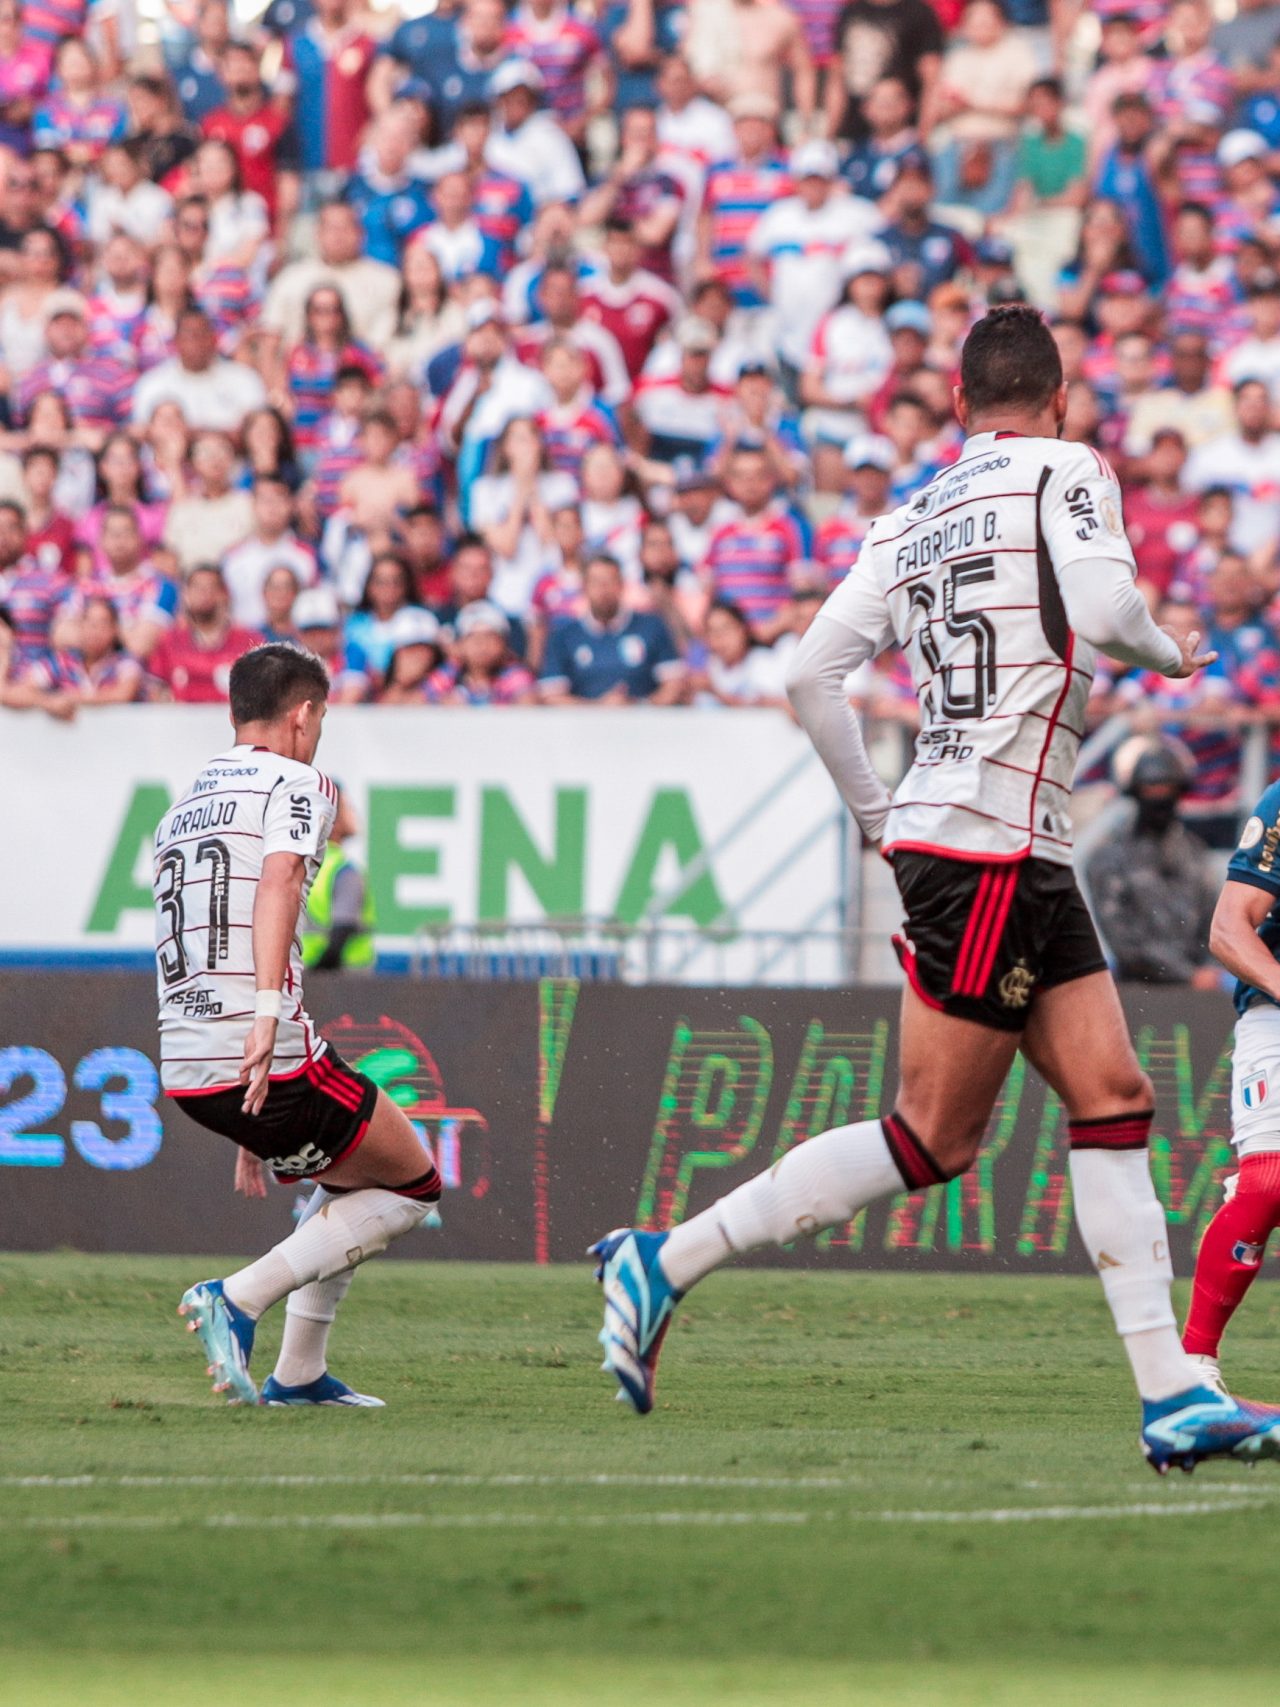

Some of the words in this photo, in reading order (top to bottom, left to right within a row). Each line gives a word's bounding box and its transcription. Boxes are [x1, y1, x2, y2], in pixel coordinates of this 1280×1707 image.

[896, 516, 974, 577] FABRÍCIO
[984, 511, 1002, 541] B.
[169, 800, 237, 840] ARAÚJO
[84, 779, 738, 940] AENA
